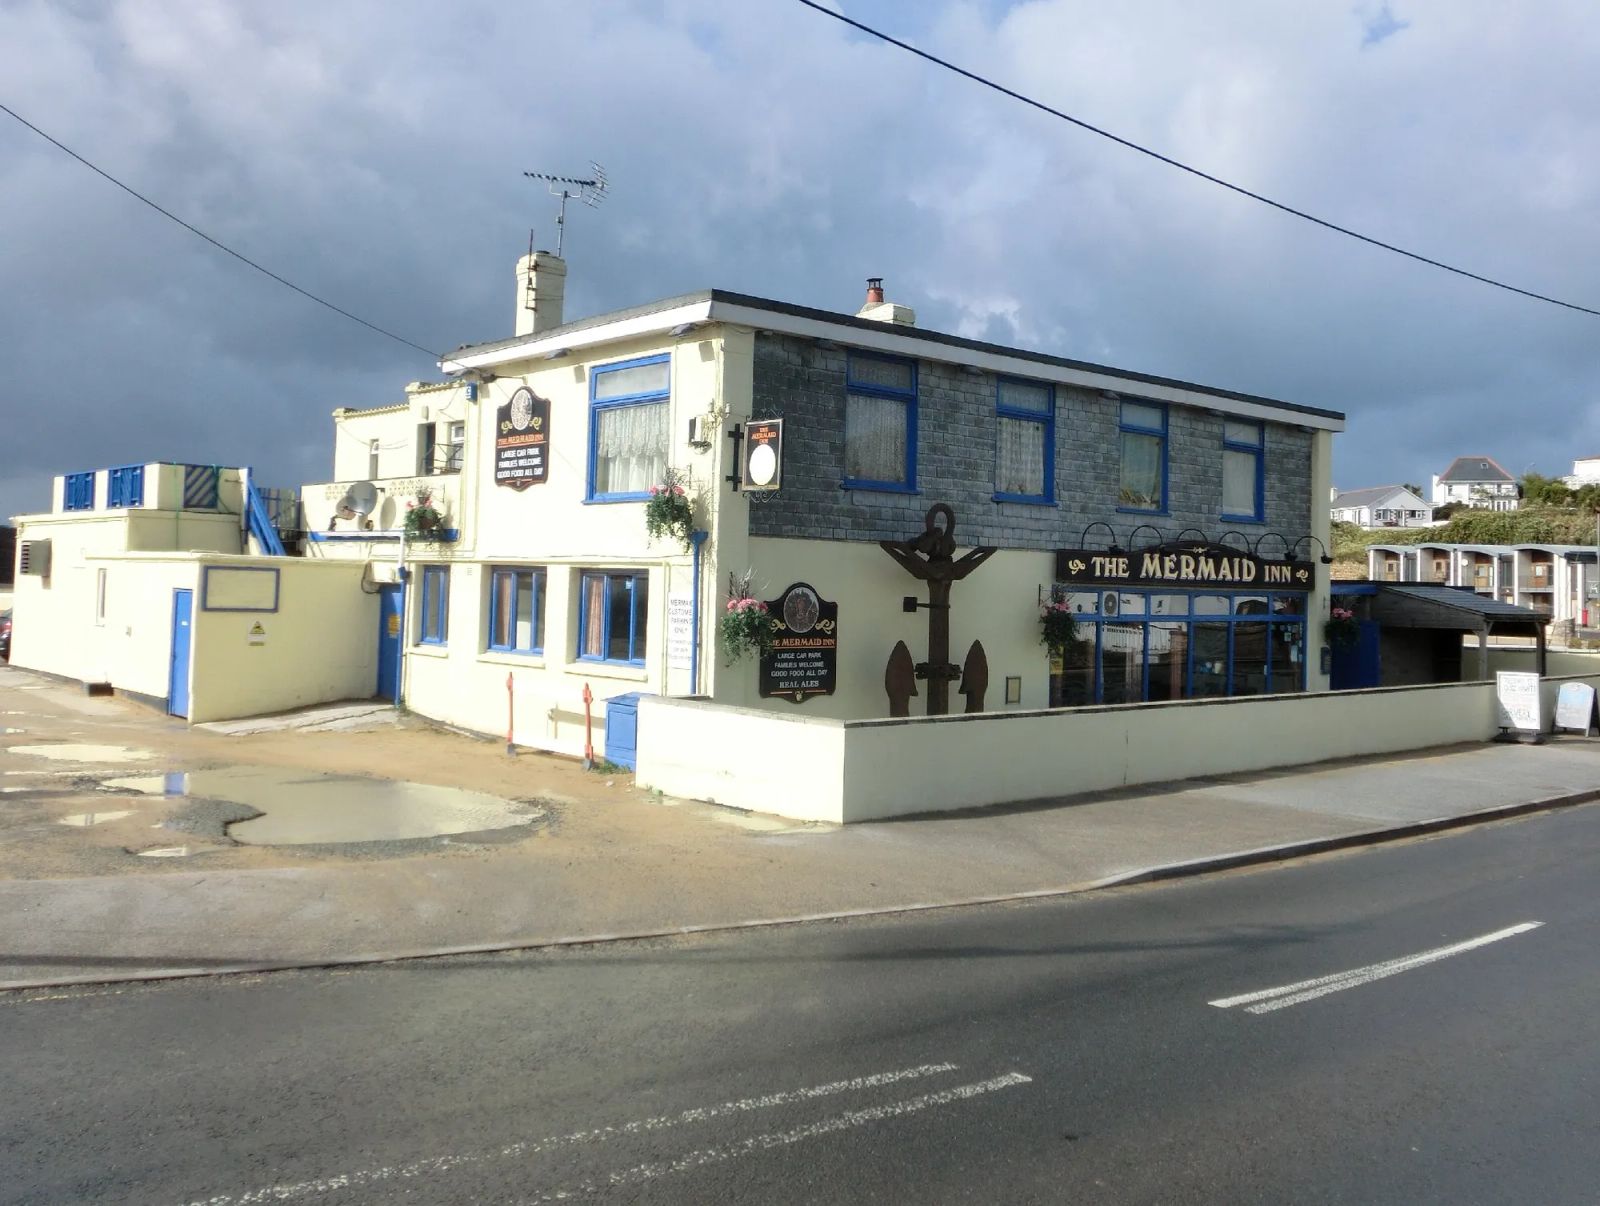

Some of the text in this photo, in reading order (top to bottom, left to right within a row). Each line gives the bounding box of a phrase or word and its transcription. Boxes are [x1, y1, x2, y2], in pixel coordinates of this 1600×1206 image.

[501, 450, 516, 458] LARGE
[517, 449, 526, 457] CAR
[518, 457, 542, 466] WELCOME
[497, 470, 510, 478] GOOD
[1090, 553, 1292, 582] THE MERMAID INN
[782, 638, 822, 646] MERMAID
